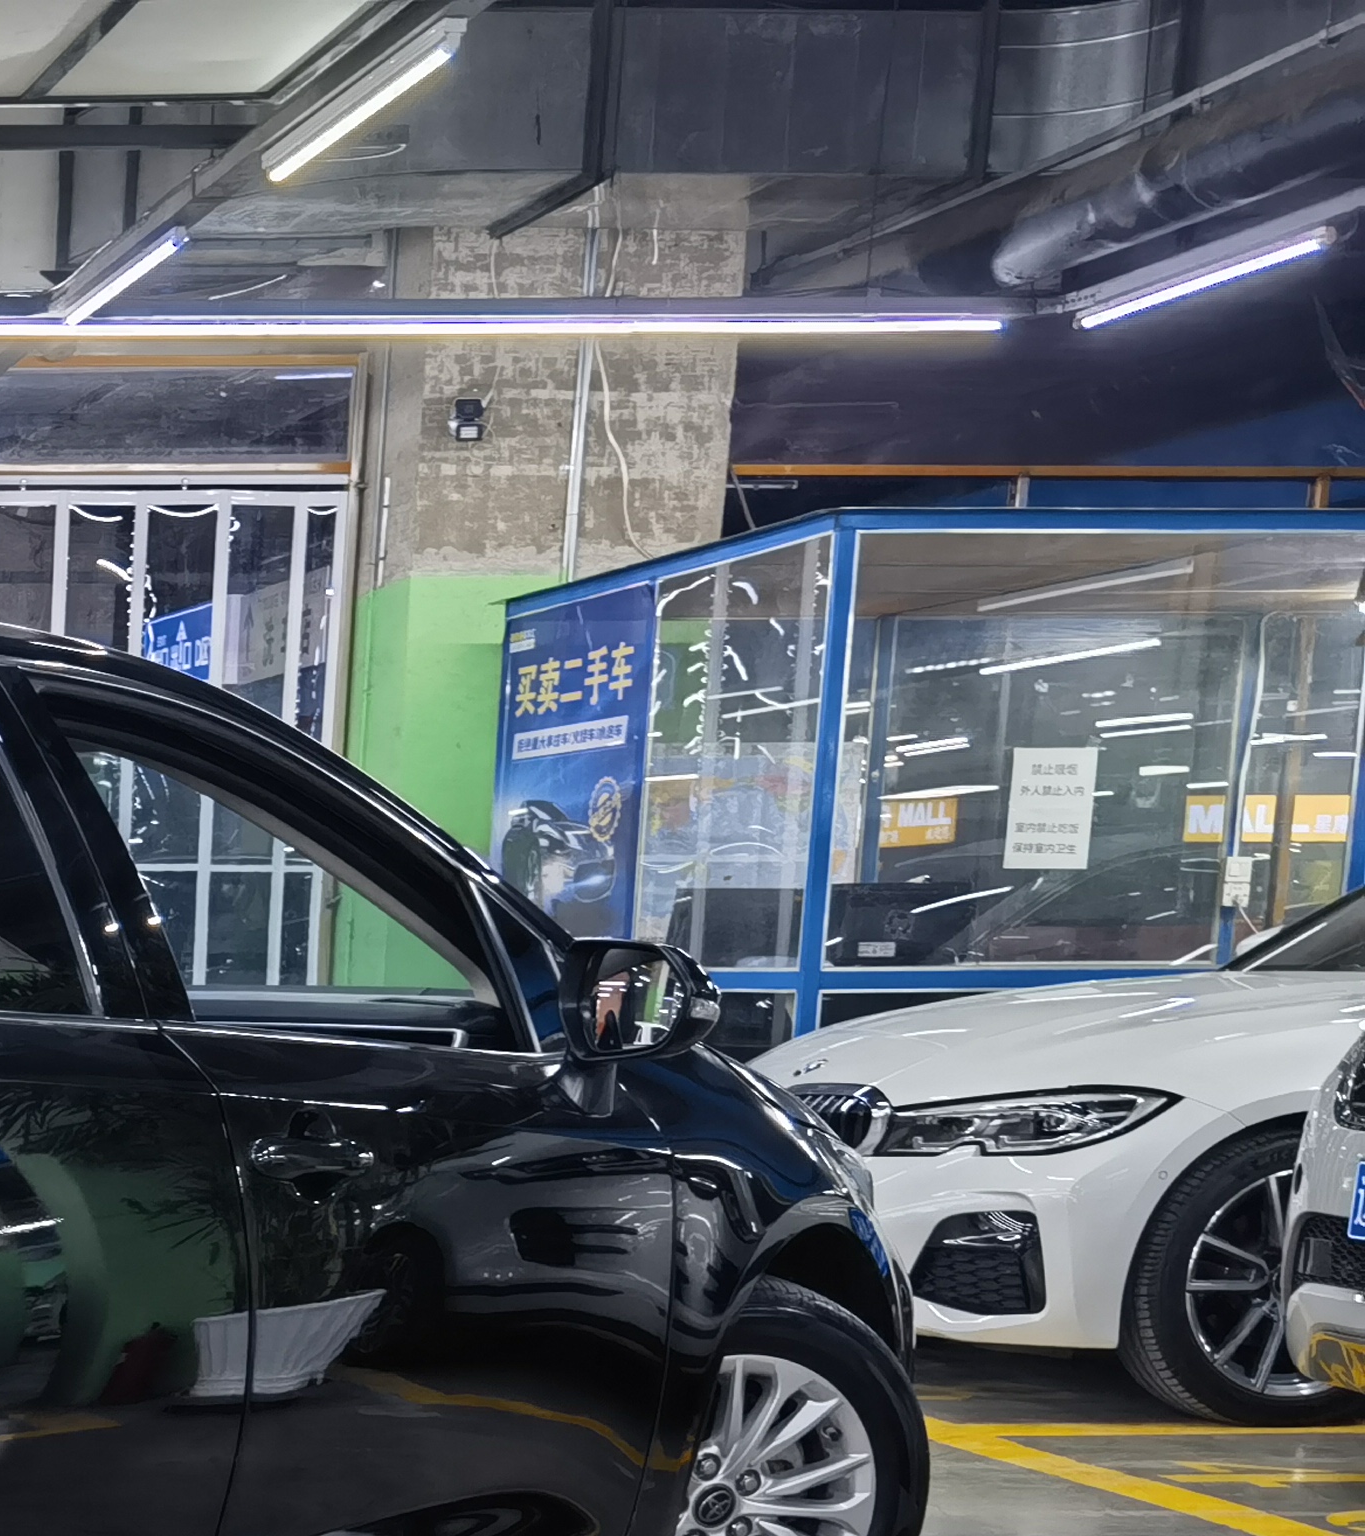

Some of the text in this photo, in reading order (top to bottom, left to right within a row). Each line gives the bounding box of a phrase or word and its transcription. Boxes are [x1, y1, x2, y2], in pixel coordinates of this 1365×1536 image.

[515, 641, 635, 718] 买卖二手车
[1020, 785, 1084, 797] 外人禁止入内
[898, 801, 951, 828] MALL
